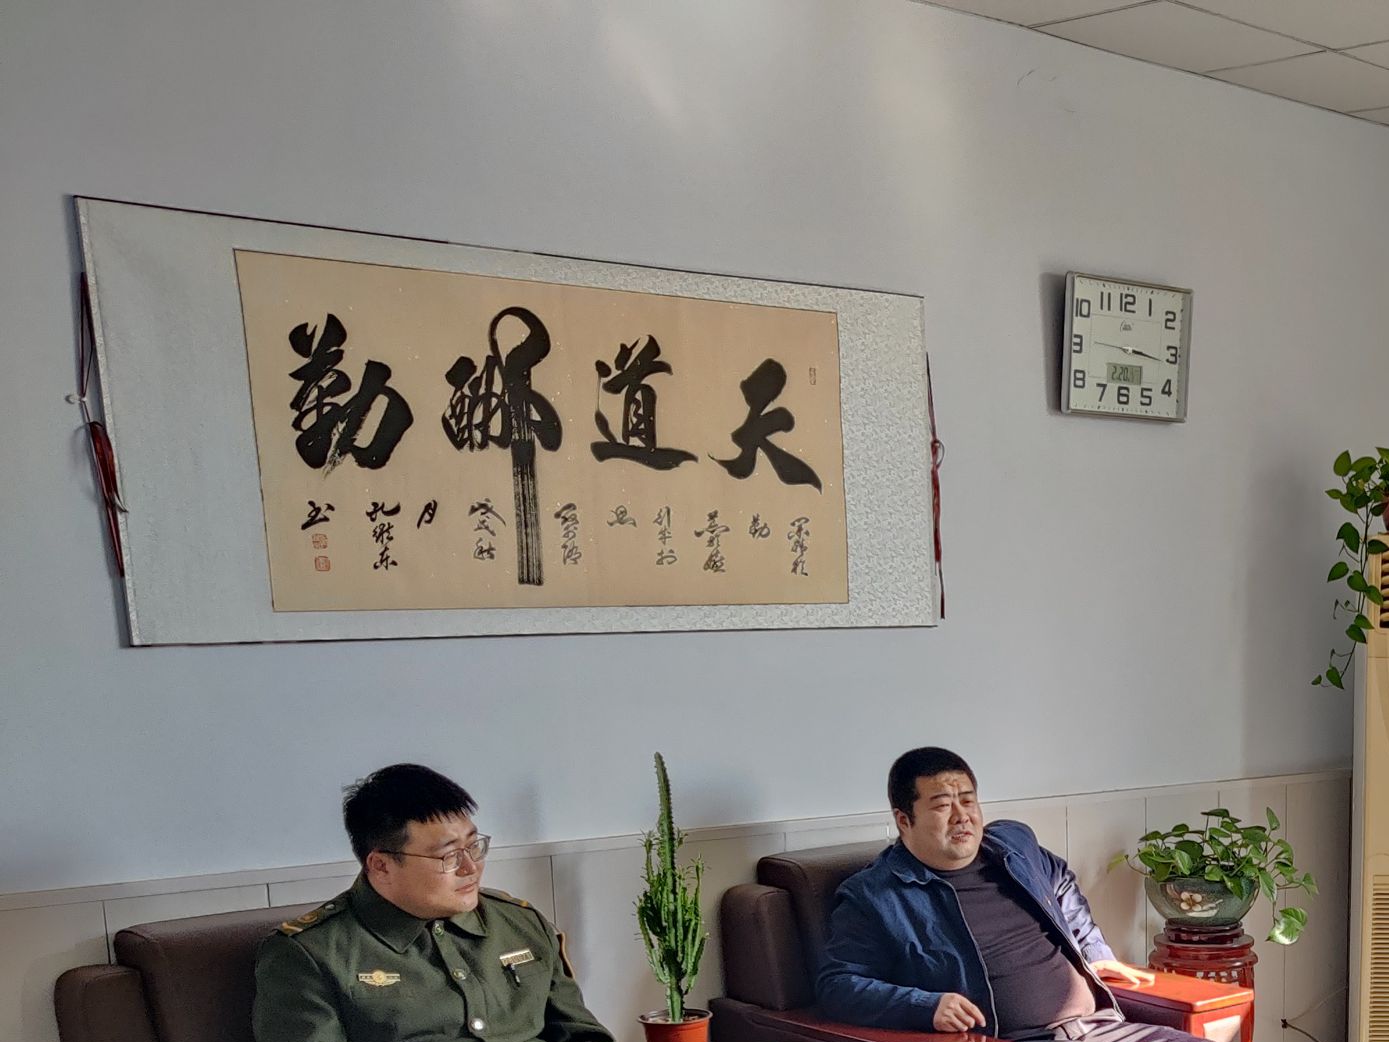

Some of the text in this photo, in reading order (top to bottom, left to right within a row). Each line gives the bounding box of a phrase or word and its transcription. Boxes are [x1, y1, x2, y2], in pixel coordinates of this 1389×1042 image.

[1075, 297, 1091, 318] 10
[1100, 291, 1111, 311] 11
[1119, 292, 1136, 313] 12
[1148, 298, 1152, 317] 1
[1164, 310, 1176, 330] 2
[1166, 345, 1178, 365] 3
[1073, 369, 1086, 389] 8
[1161, 378, 1172, 397] 4
[1096, 383, 1107, 402] 7
[1116, 386, 1129, 405] 6
[1140, 387, 1152, 406] 5
